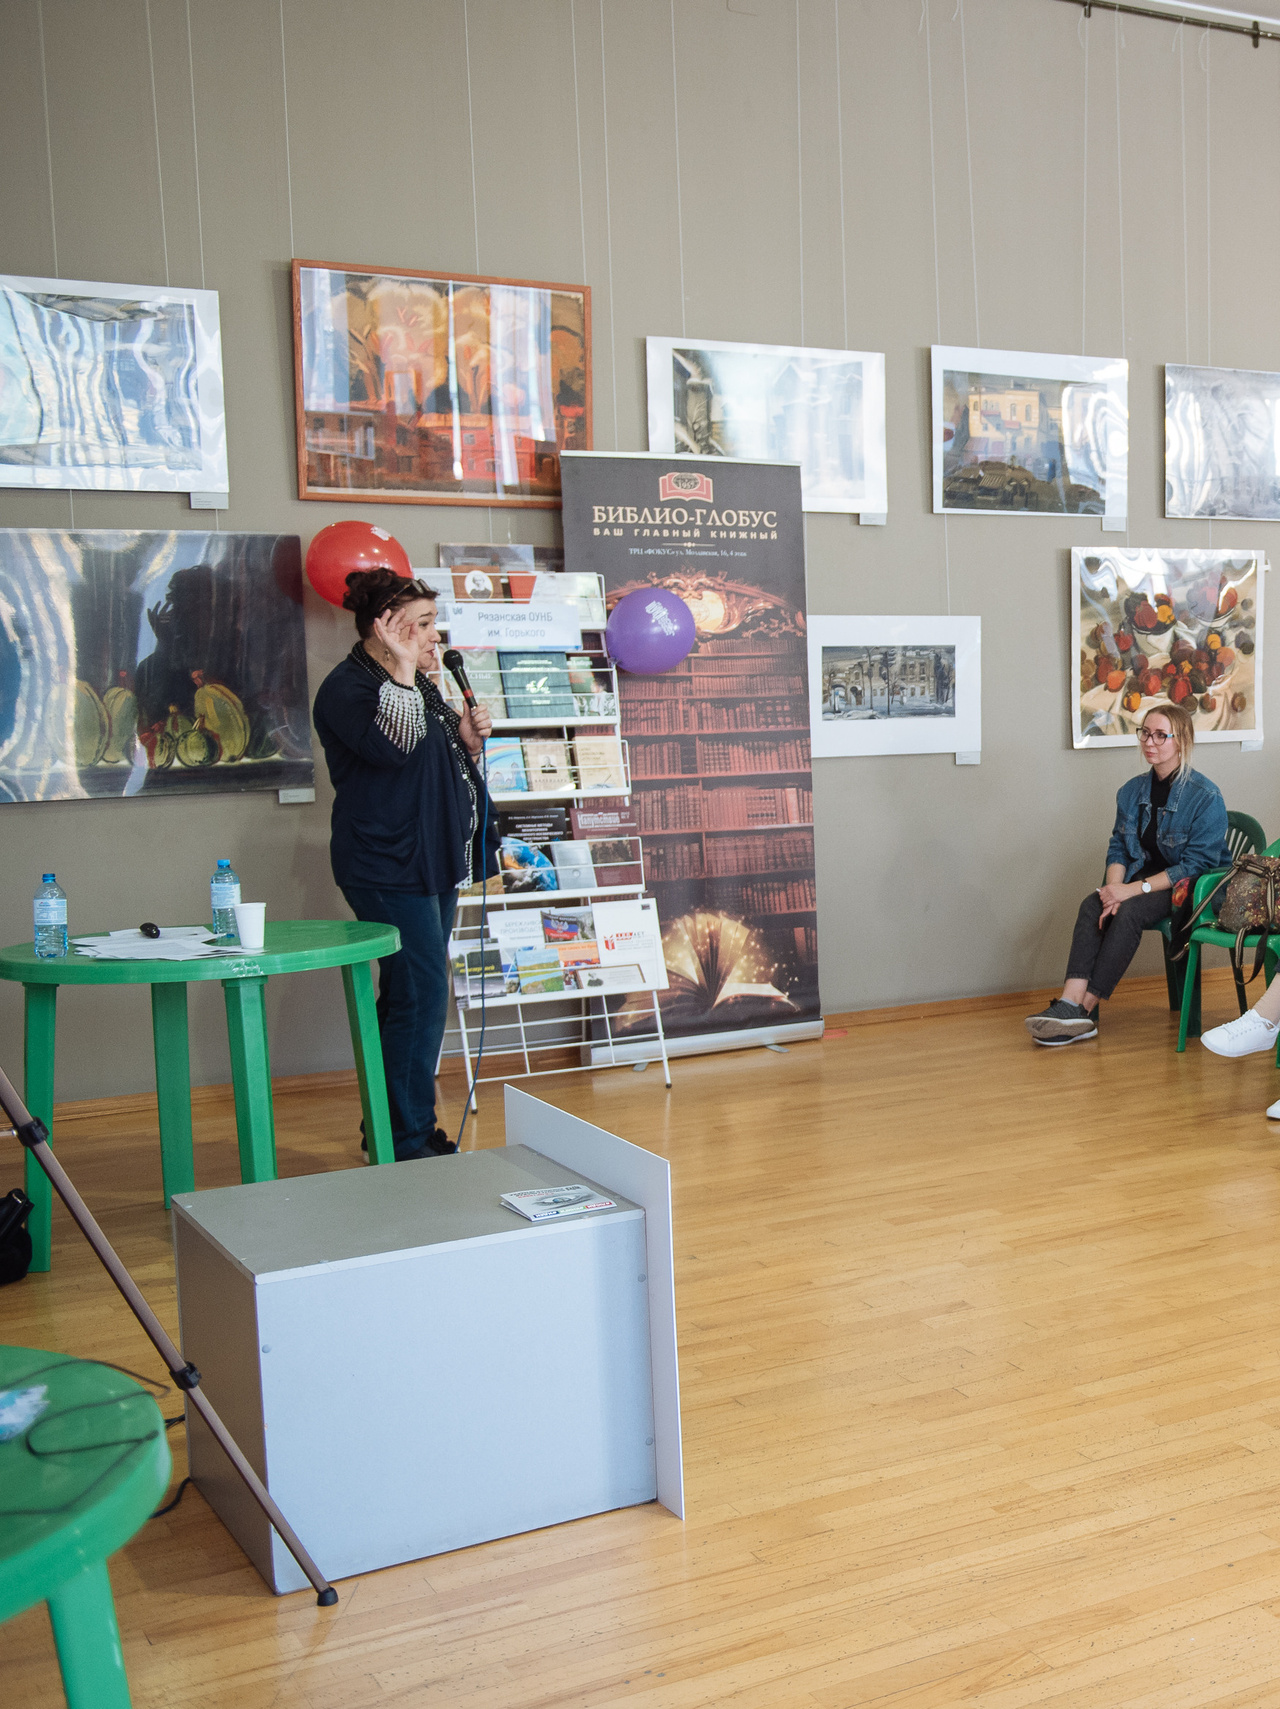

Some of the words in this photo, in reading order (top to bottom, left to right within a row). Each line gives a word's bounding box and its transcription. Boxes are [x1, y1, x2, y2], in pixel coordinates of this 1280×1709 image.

[592, 505, 778, 528] БИБЛИО-ГЛОБУС
[593, 527, 624, 537] ВАШ
[633, 527, 701, 538] ГЛАВНЫЙ
[710, 530, 778, 540] КНИЖНЫЙ
[477, 611, 527, 622] Рязанская
[528, 611, 553, 622] ОУНБ
[487, 629, 502, 638] им.
[505, 627, 546, 639] Горького
